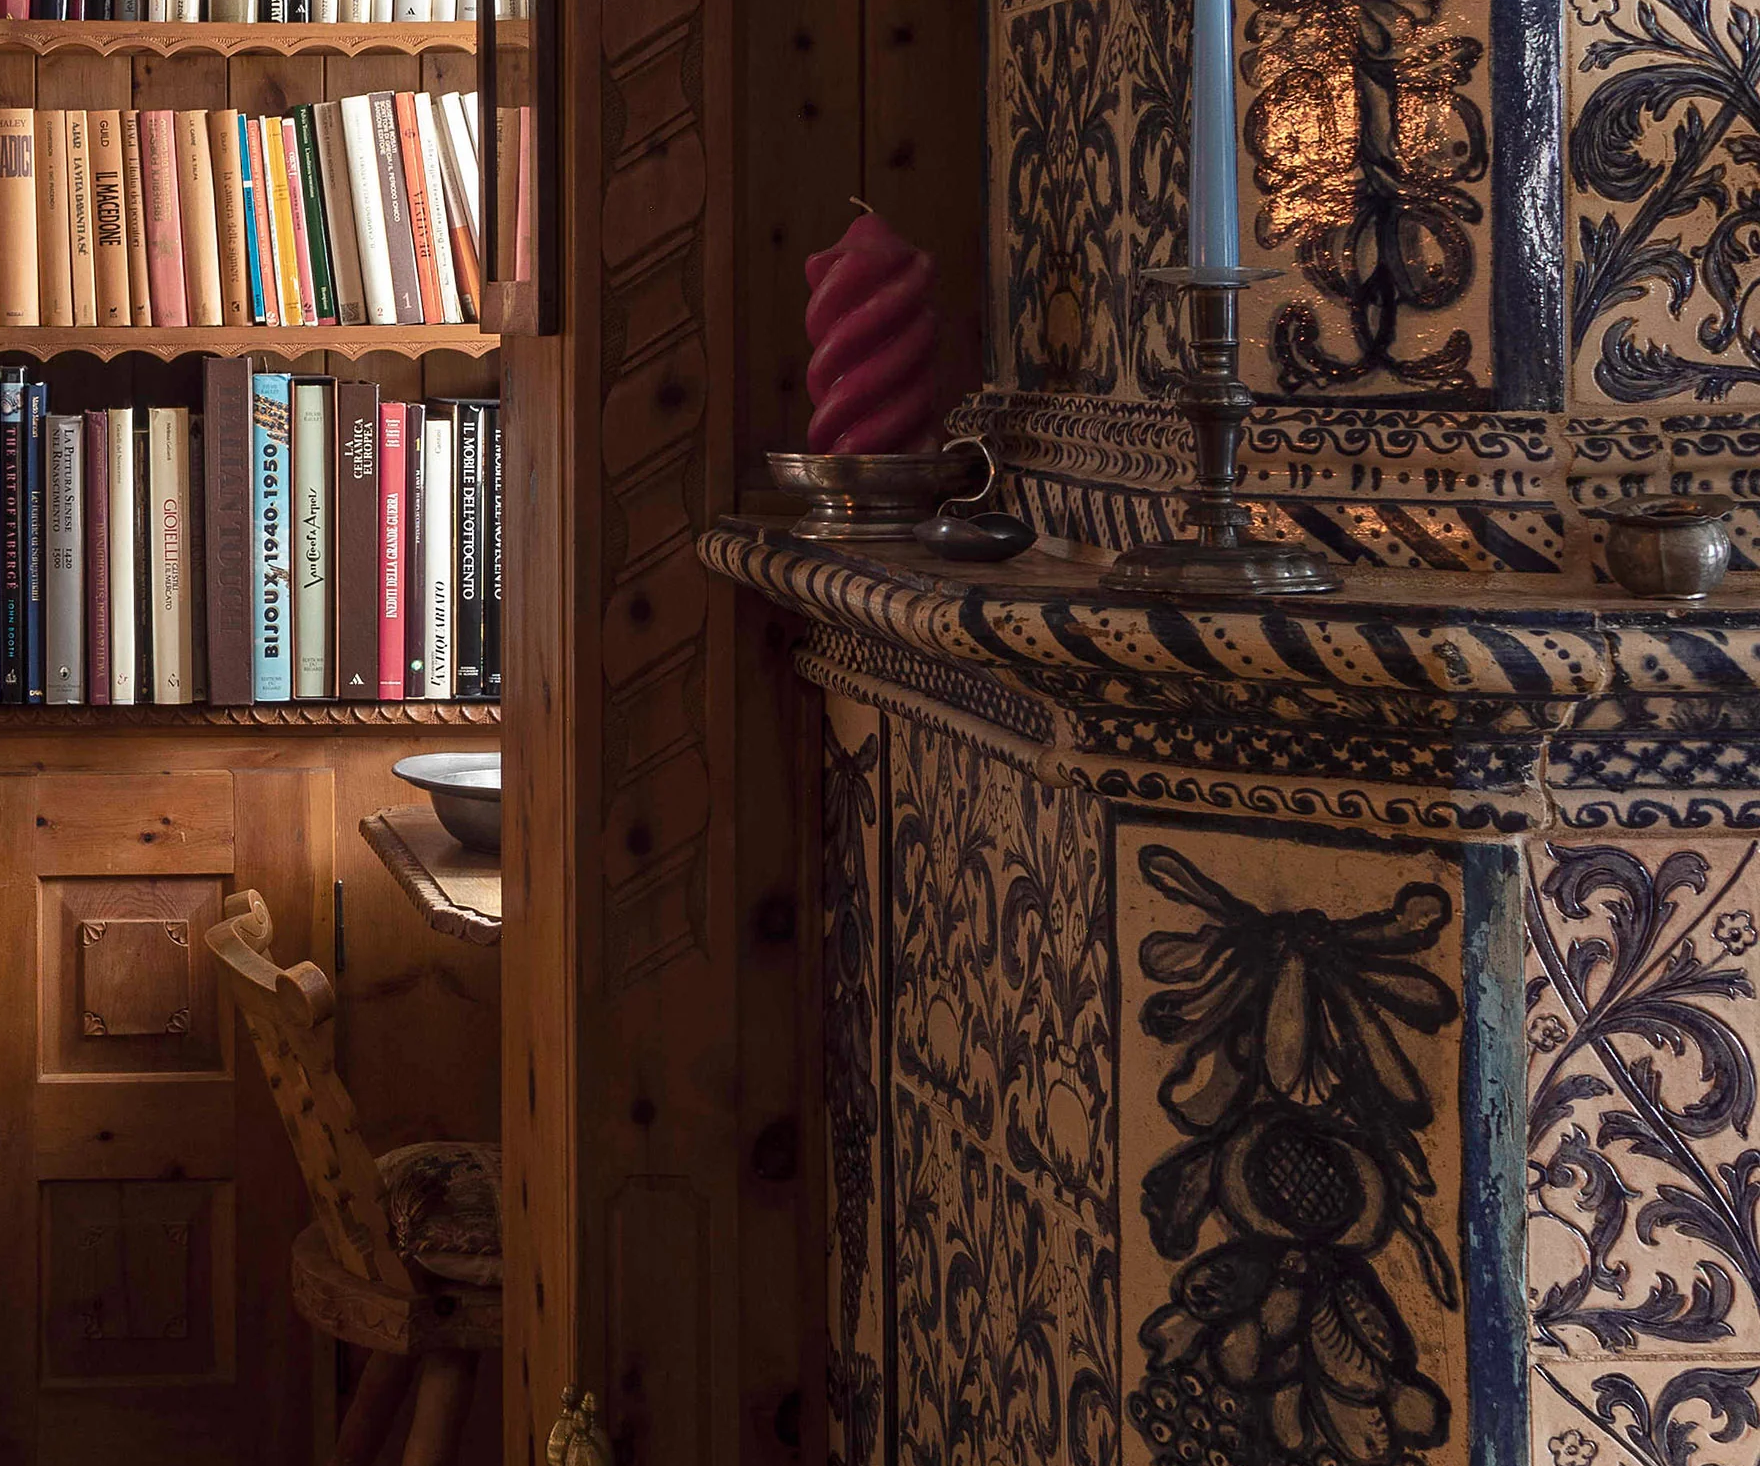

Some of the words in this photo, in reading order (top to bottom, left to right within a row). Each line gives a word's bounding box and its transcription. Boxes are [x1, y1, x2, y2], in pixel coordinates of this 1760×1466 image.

[100, 120, 110, 147] GUILD
[96, 172, 118, 181] IL
[96, 184, 121, 246] MACEDONE
[6, 428, 17, 456] THE
[52, 429, 61, 447] NEL
[64, 429, 74, 443] LA
[461, 422, 474, 433] IL
[345, 441, 354, 456] LA
[354, 418, 364, 479] CERAMICA
[363, 422, 373, 475] EUROPEA
[461, 437, 475, 483] MOBILE
[6, 463, 17, 491] ART
[63, 446, 74, 493] PITTURA
[51, 450, 62, 532] RINASCIMENTO
[6, 497, 17, 516] OF
[63, 495, 74, 533] SENESE
[387, 493, 399, 524] GUERRA
[6, 523, 18, 590] FABERGÉ
[386, 527, 399, 559] GRANDE
[462, 487, 475, 600] DELL'OTTOCENTO
[53, 548, 61, 569] 1500
[65, 548, 73, 569] 1420
[386, 561, 398, 587] DELLA
[263, 572, 279, 658] BIJOUX
[386, 589, 398, 618] INEDITI
[7, 627, 15, 658] BOOTH
